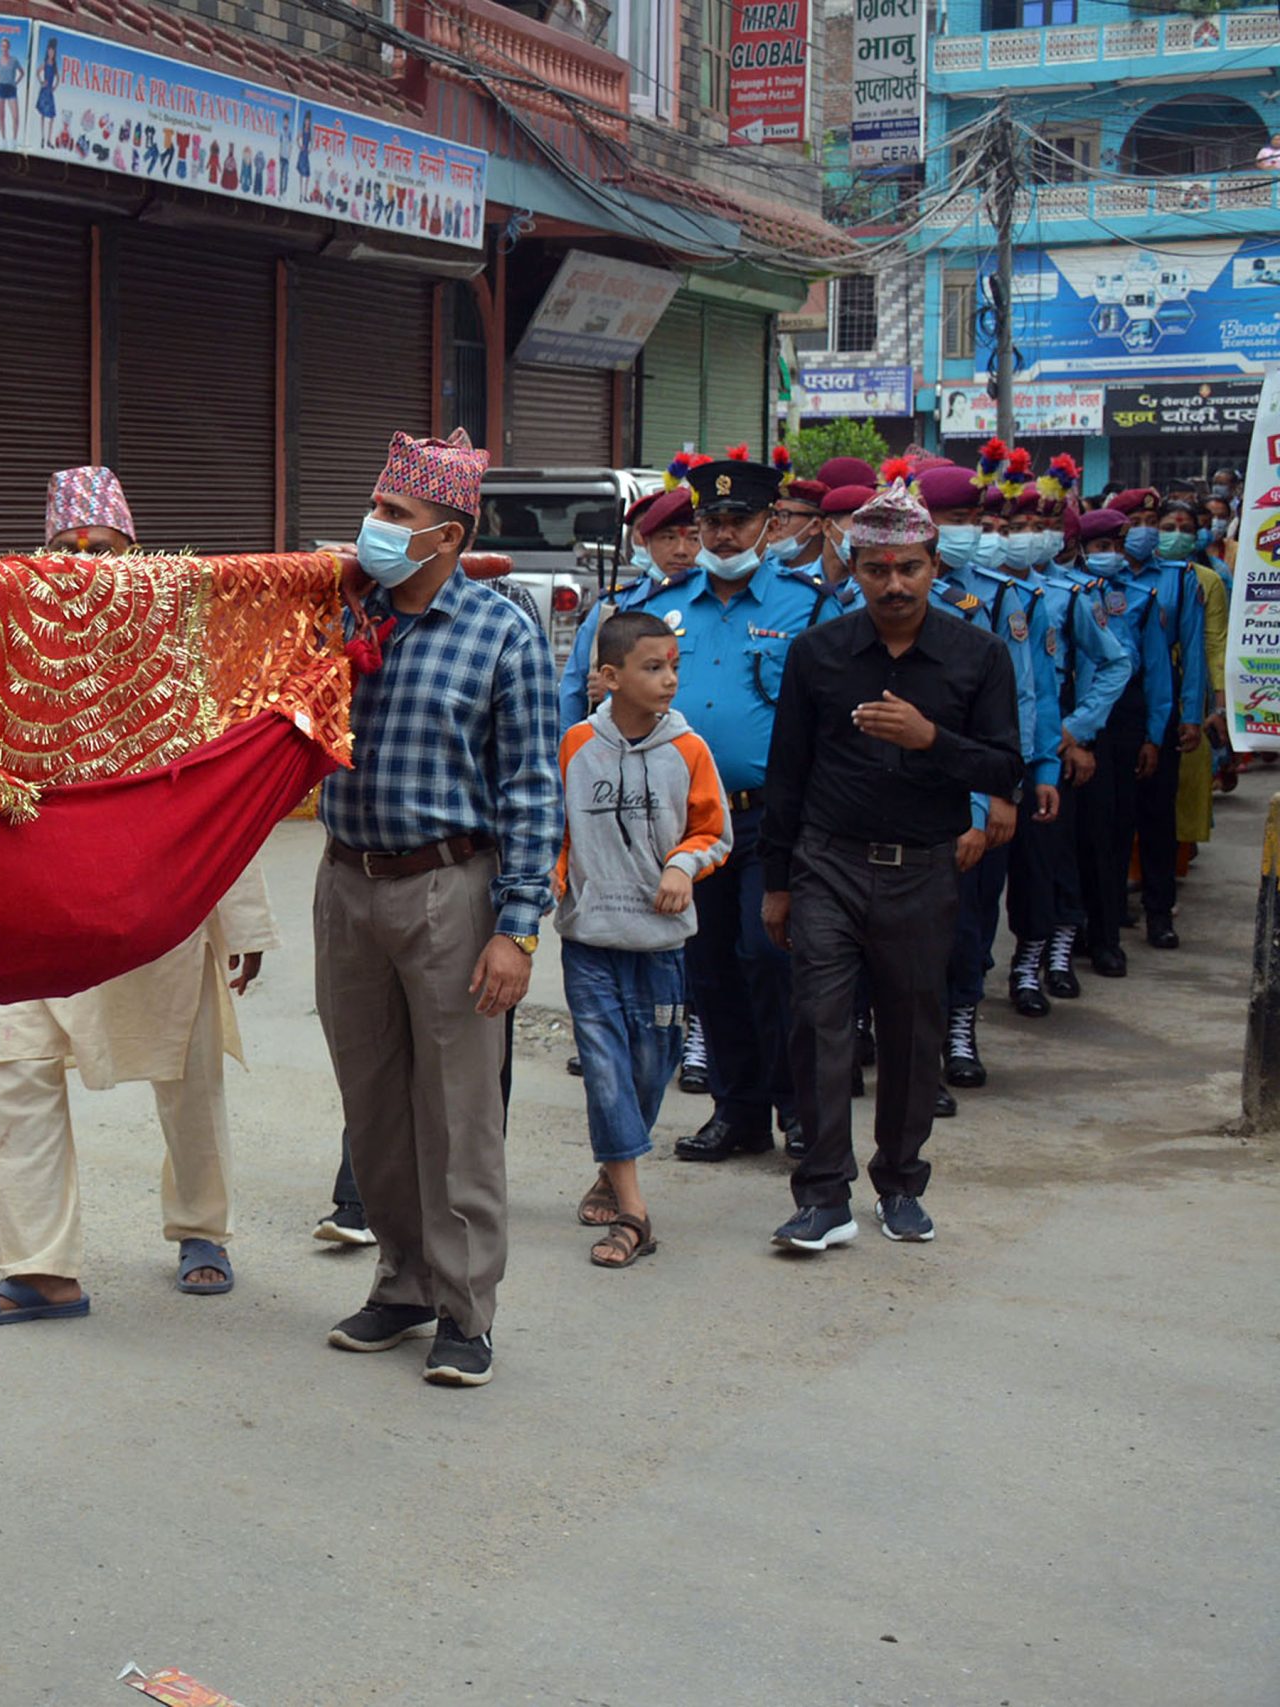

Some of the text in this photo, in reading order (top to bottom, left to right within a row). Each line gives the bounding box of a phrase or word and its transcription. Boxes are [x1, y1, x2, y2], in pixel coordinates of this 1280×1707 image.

[741, 3, 797, 32] MIRAI
[731, 38, 804, 70] GLOBAL
[858, 34, 916, 65] भानु
[61, 55, 134, 99] PRAKRITI
[134, 73, 146, 103] &
[150, 76, 200, 116] PRATIK
[200, 91, 242, 127] FANCY
[243, 102, 278, 137] PASAL
[881, 145, 919, 161] CERA
[804, 373, 856, 390] पसल
[1112, 410, 1158, 428] सुन
[1241, 634, 1280, 646] HYU
